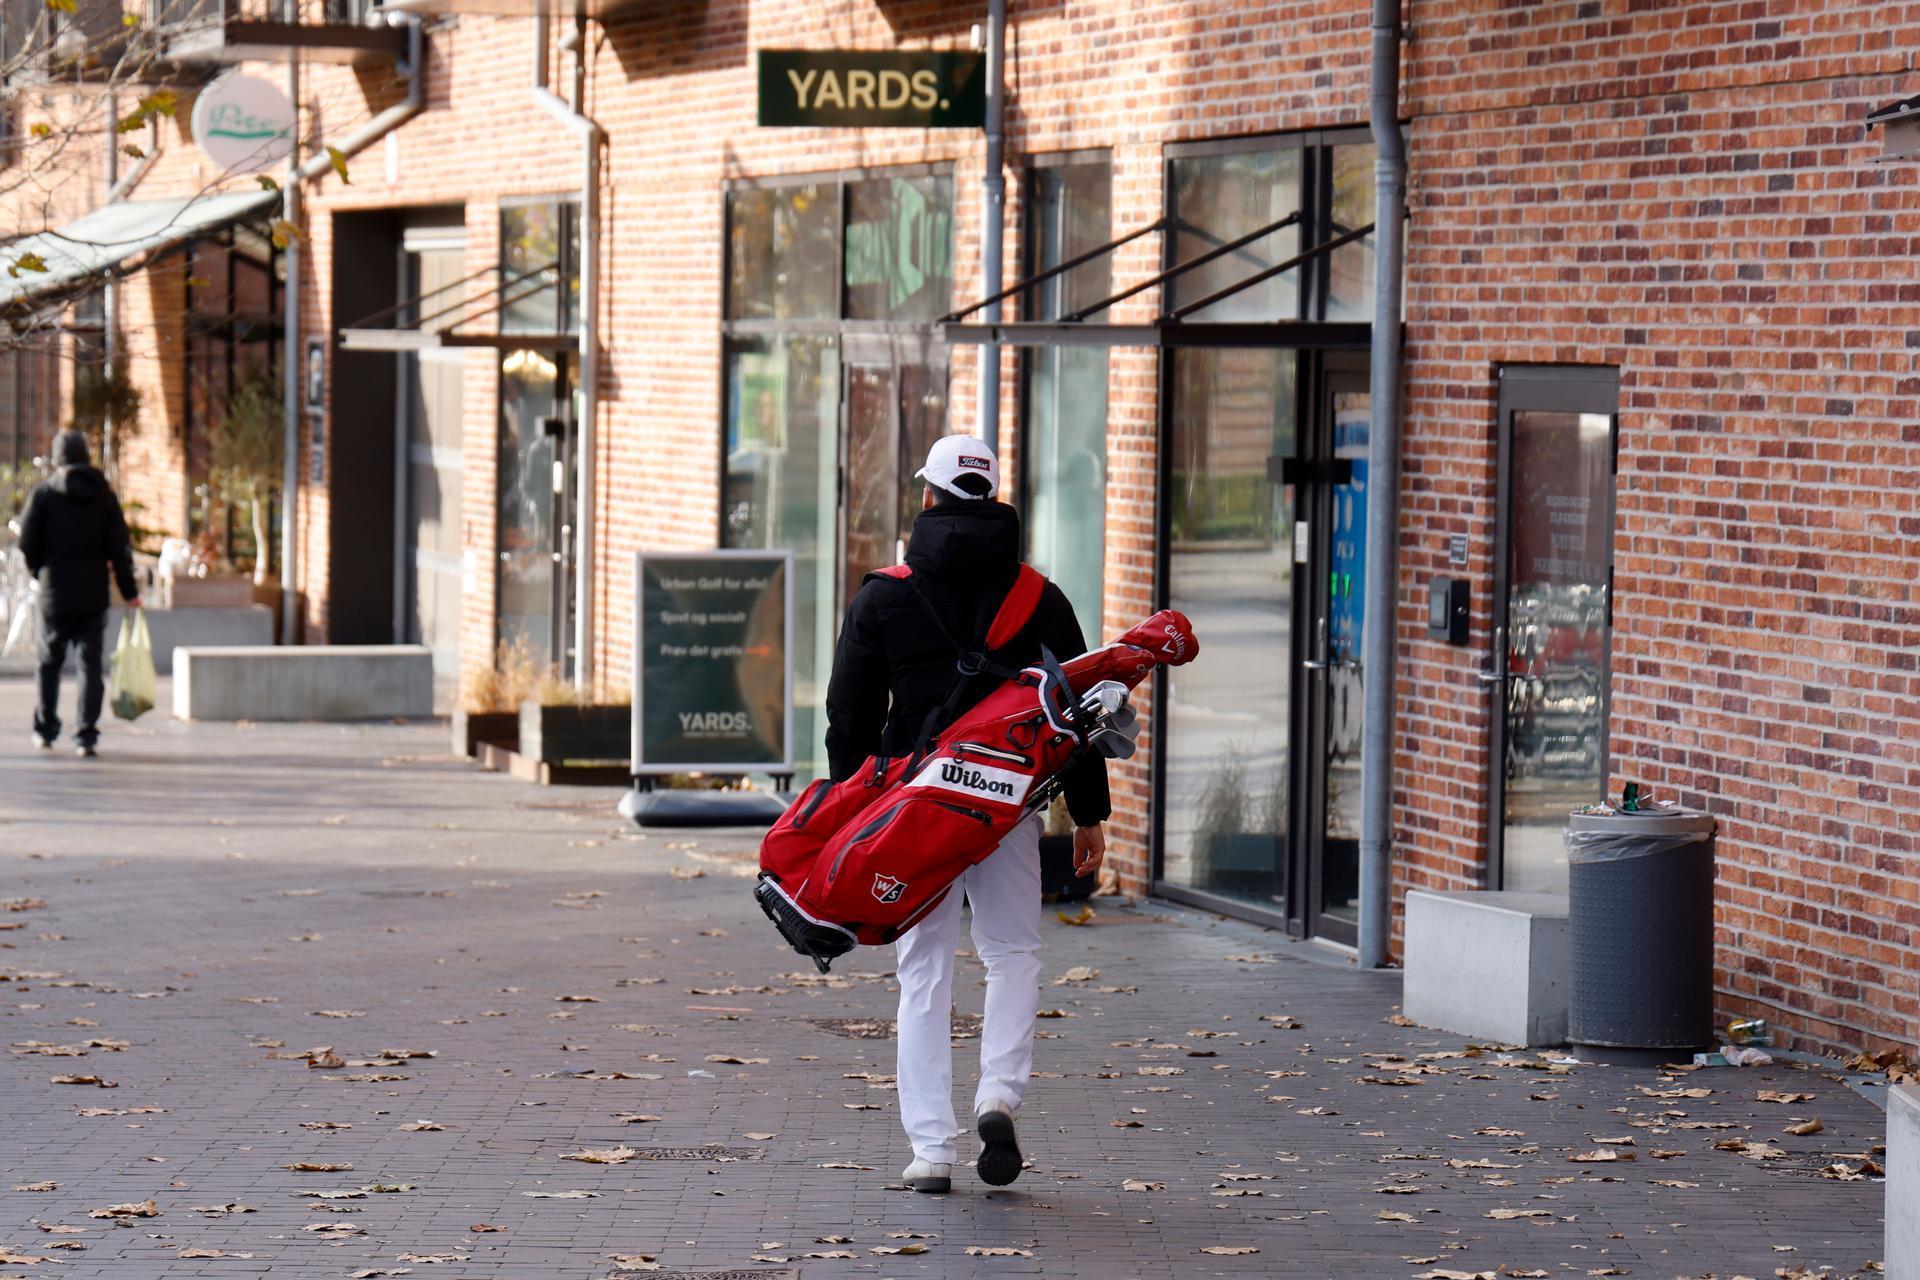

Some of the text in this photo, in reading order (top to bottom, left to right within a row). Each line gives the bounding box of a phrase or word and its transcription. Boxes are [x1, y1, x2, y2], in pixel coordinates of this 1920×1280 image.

[787, 69, 950, 110] YARDS.
[660, 576, 696, 590] Urban
[697, 576, 722, 590] Golf
[724, 576, 741, 590] for
[660, 610, 689, 625] Sjovt
[691, 613, 708, 627] og
[689, 643, 709, 657] det
[710, 644, 743, 660] gratis
[678, 711, 753, 732] YARDS.
[941, 763, 1014, 797] Wilson
